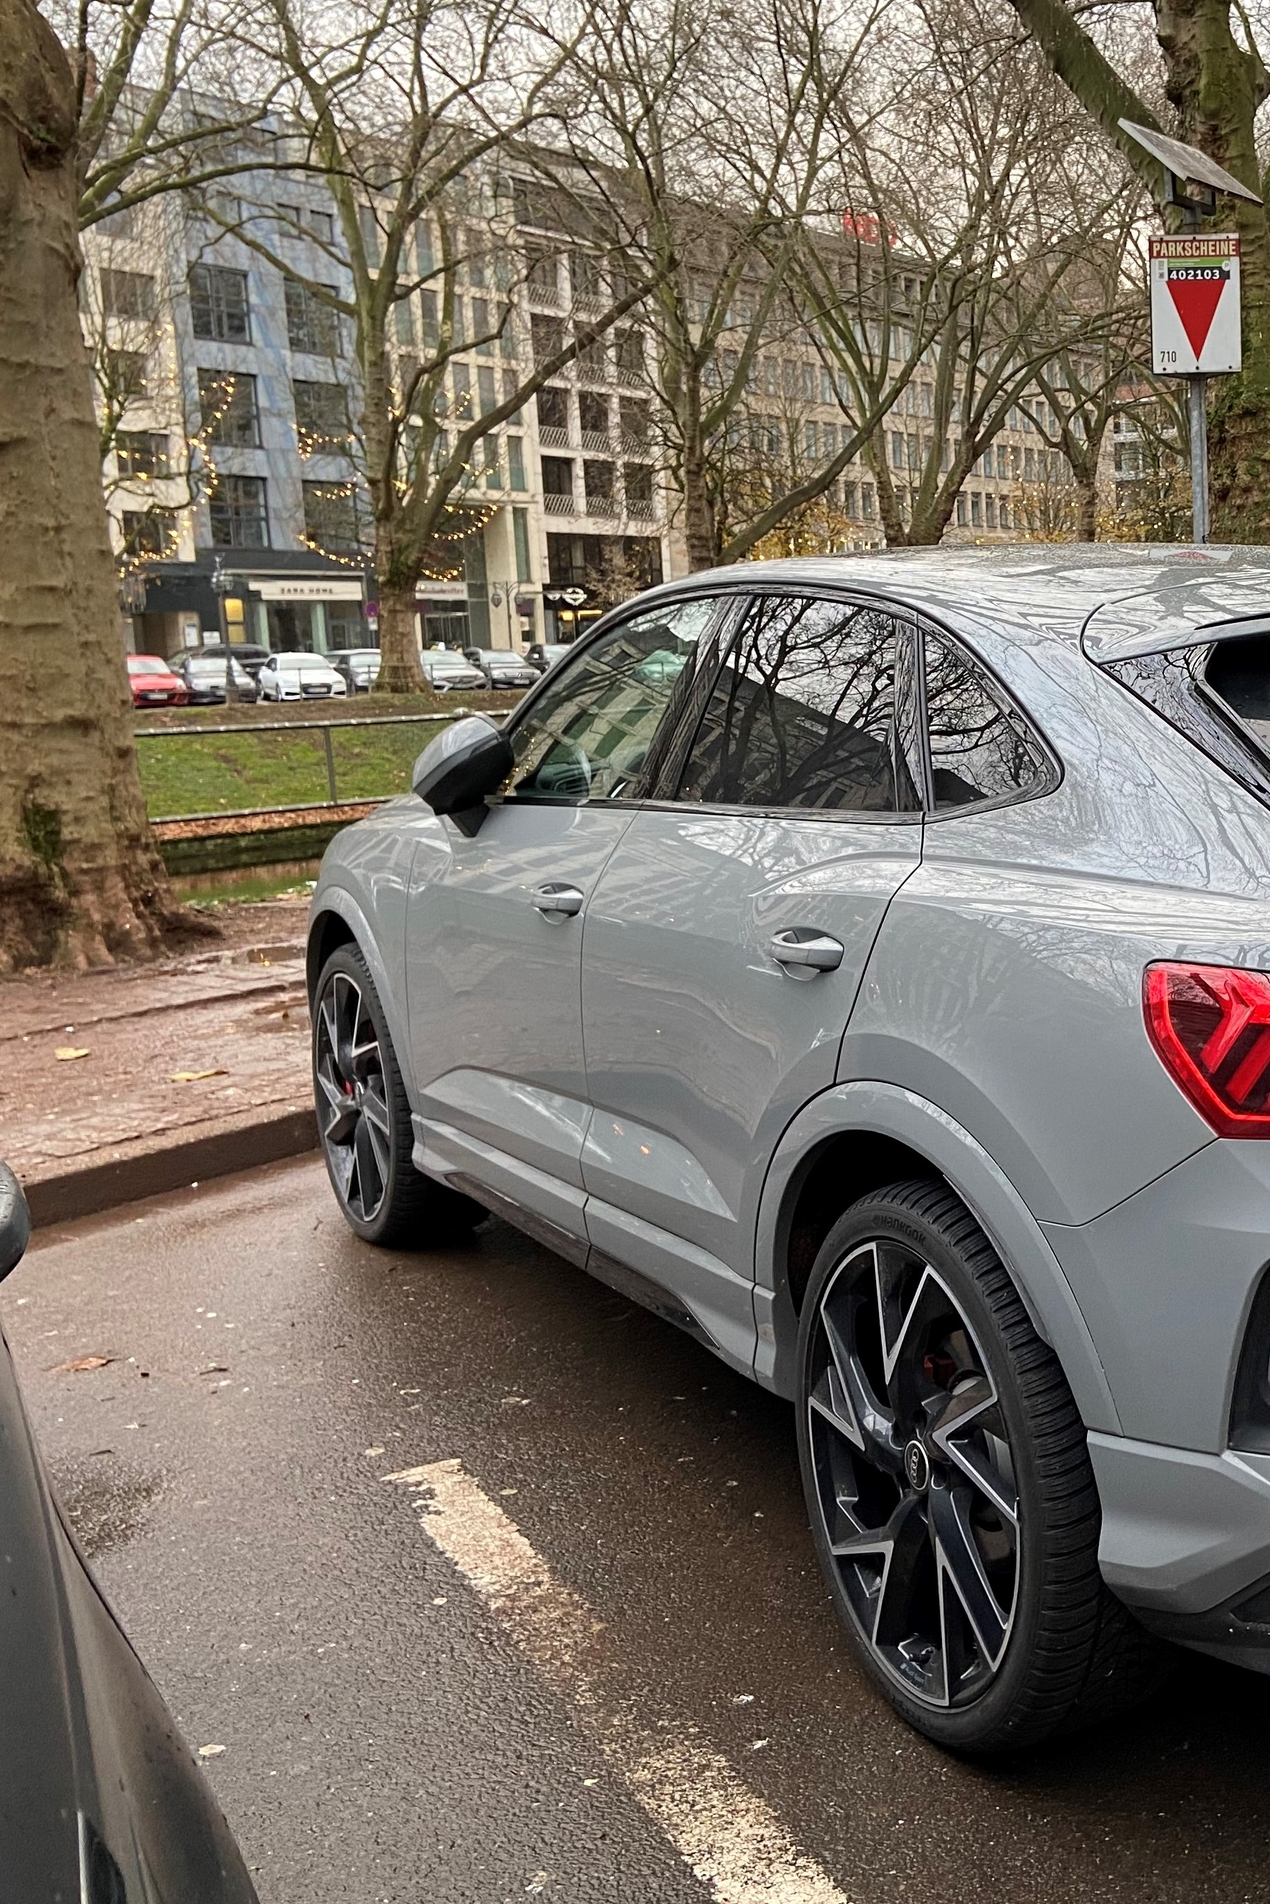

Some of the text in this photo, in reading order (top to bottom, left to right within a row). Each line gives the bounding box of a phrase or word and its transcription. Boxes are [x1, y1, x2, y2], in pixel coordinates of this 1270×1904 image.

[1152, 240, 1237, 257] PARKSCHEINE
[1169, 270, 1220, 280] 402103
[1160, 350, 1177, 363] 710
